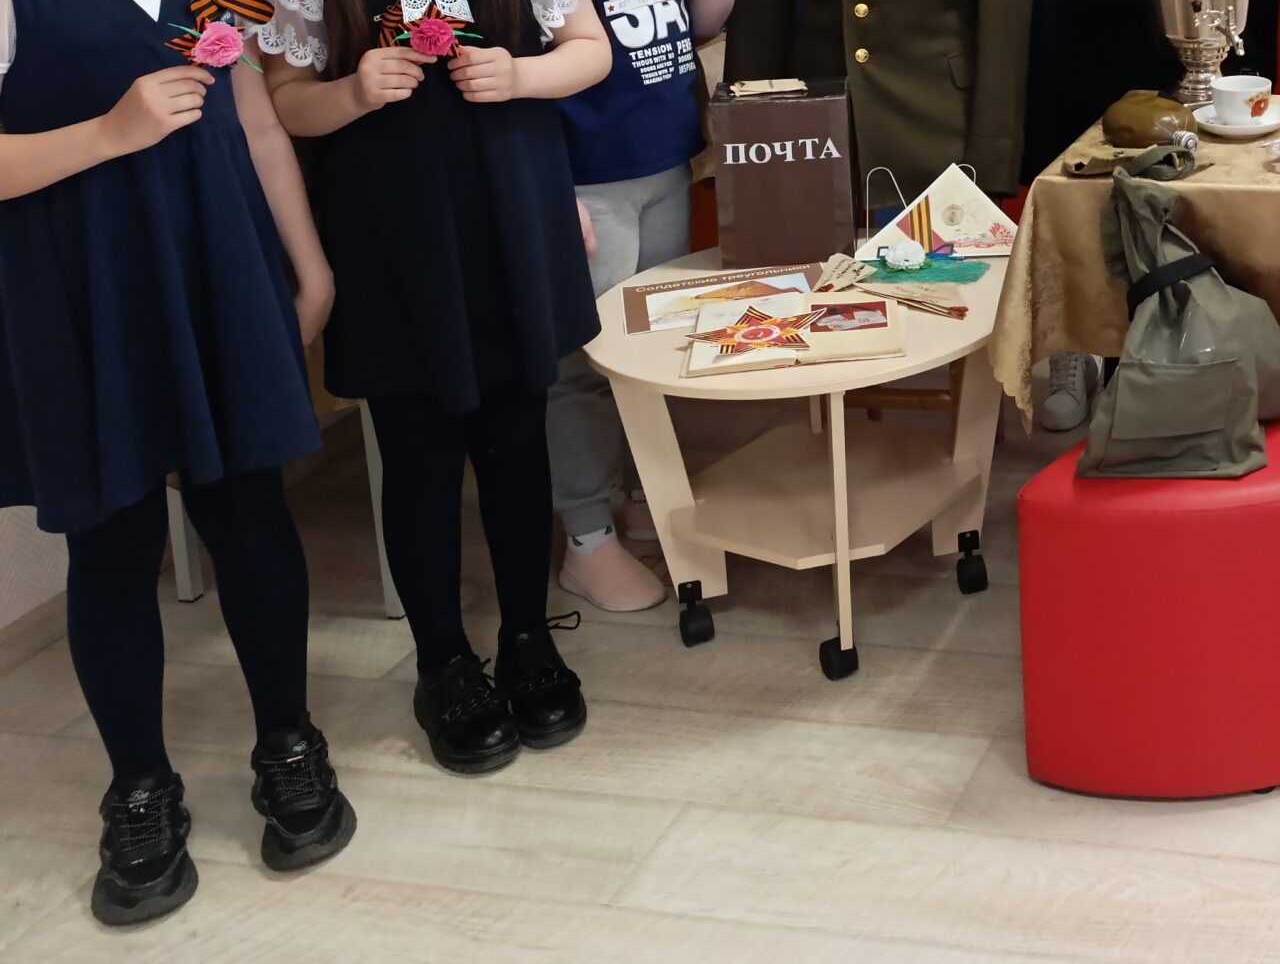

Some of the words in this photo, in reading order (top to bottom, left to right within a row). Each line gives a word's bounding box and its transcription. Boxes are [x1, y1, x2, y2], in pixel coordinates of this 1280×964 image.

[629, 43, 673, 61] TENSION
[723, 137, 842, 166] ПОЧТА
[635, 276, 718, 293] Солдатские
[722, 263, 811, 281] треугольники
